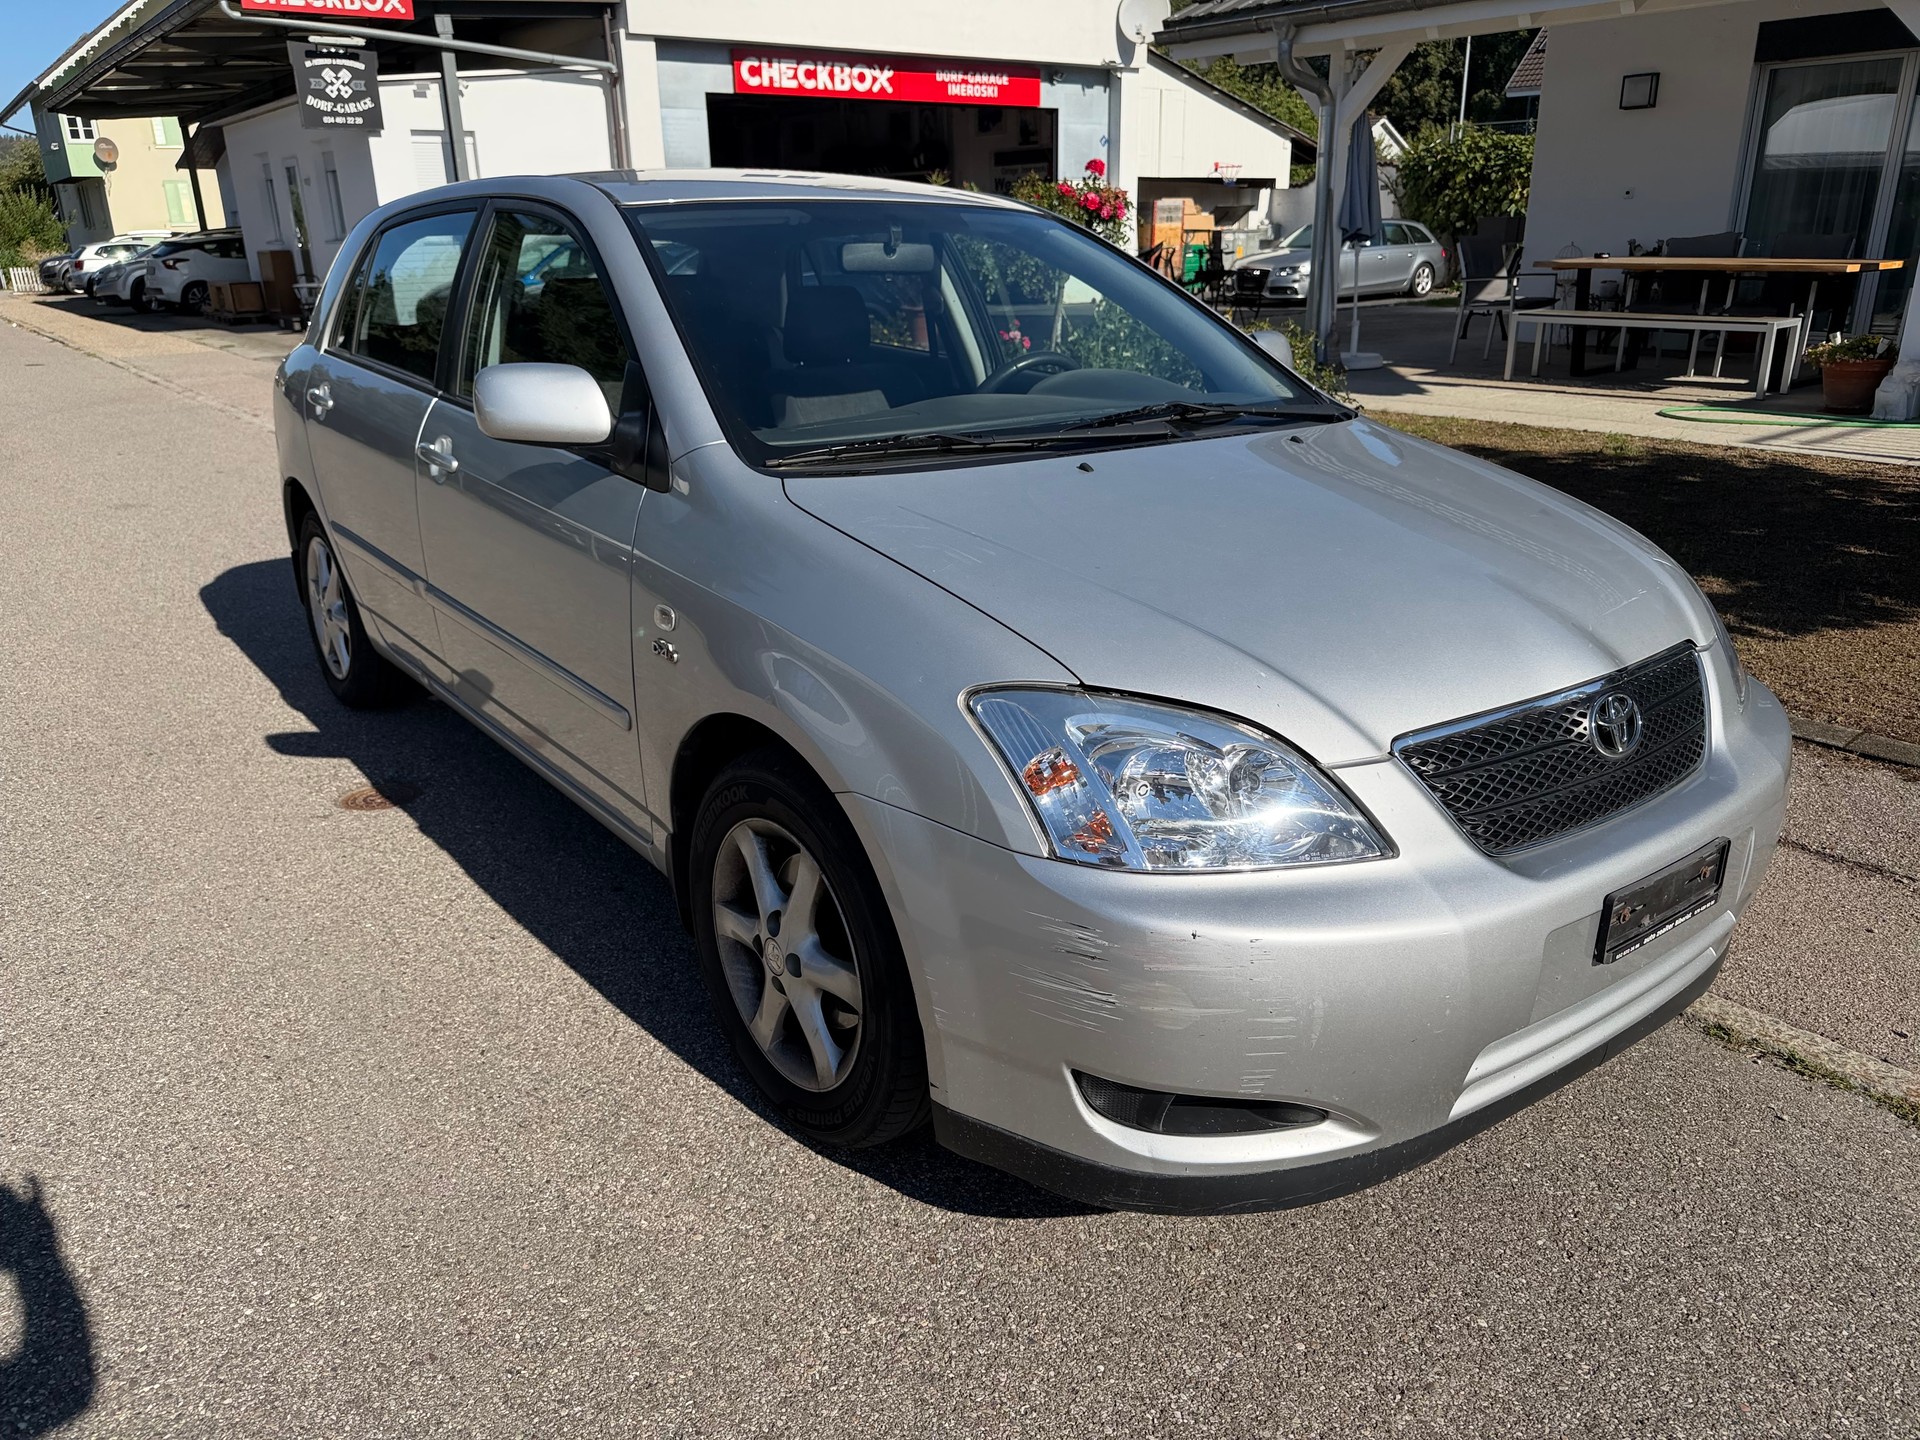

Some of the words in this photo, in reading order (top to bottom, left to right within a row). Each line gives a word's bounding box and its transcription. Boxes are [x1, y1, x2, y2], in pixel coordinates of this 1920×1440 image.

[740, 56, 895, 94] CHECKBOX
[935, 69, 1009, 86] DORF-GARAGE
[947, 82, 998, 98] IMEROSKI
[306, 95, 375, 114] DORF-GARAGE
